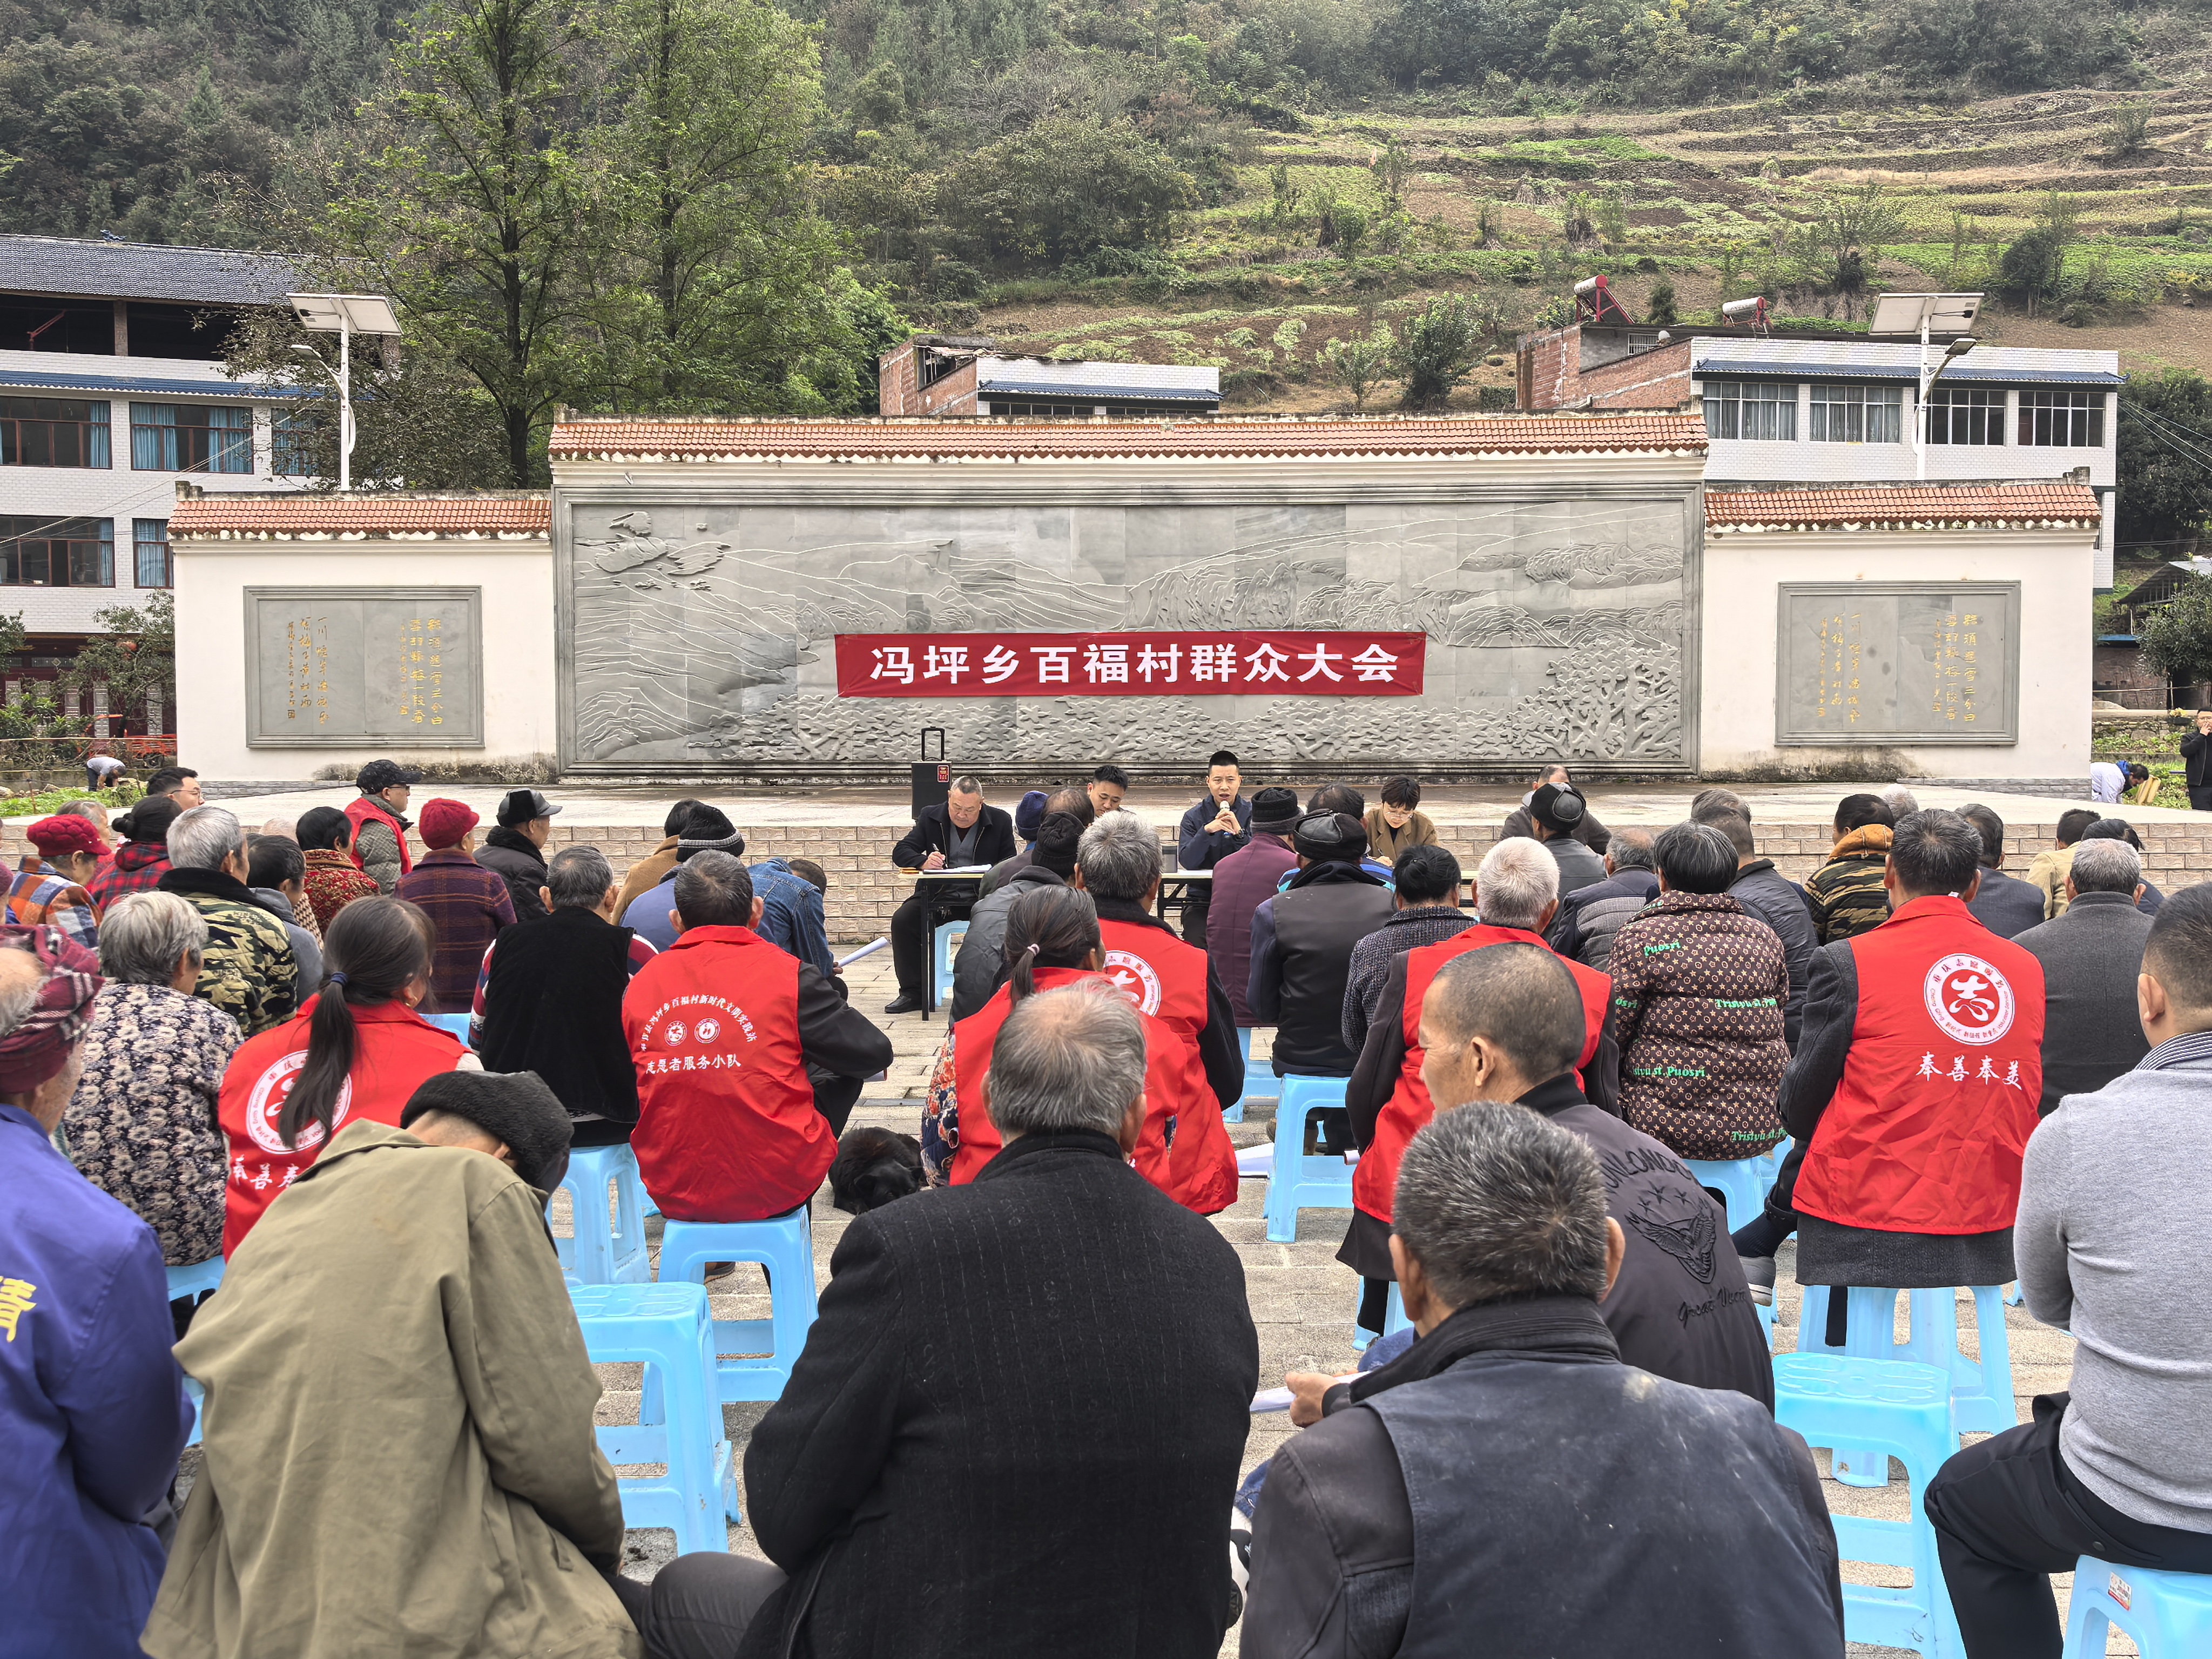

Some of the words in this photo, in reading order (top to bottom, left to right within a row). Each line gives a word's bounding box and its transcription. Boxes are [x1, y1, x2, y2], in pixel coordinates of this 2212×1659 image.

[870, 643, 1398, 684] 冯坪乡百福村群众大会
[646, 1054, 741, 1074] 志愿者服务小队
[1916, 1051, 2022, 1090] 奉善奉美
